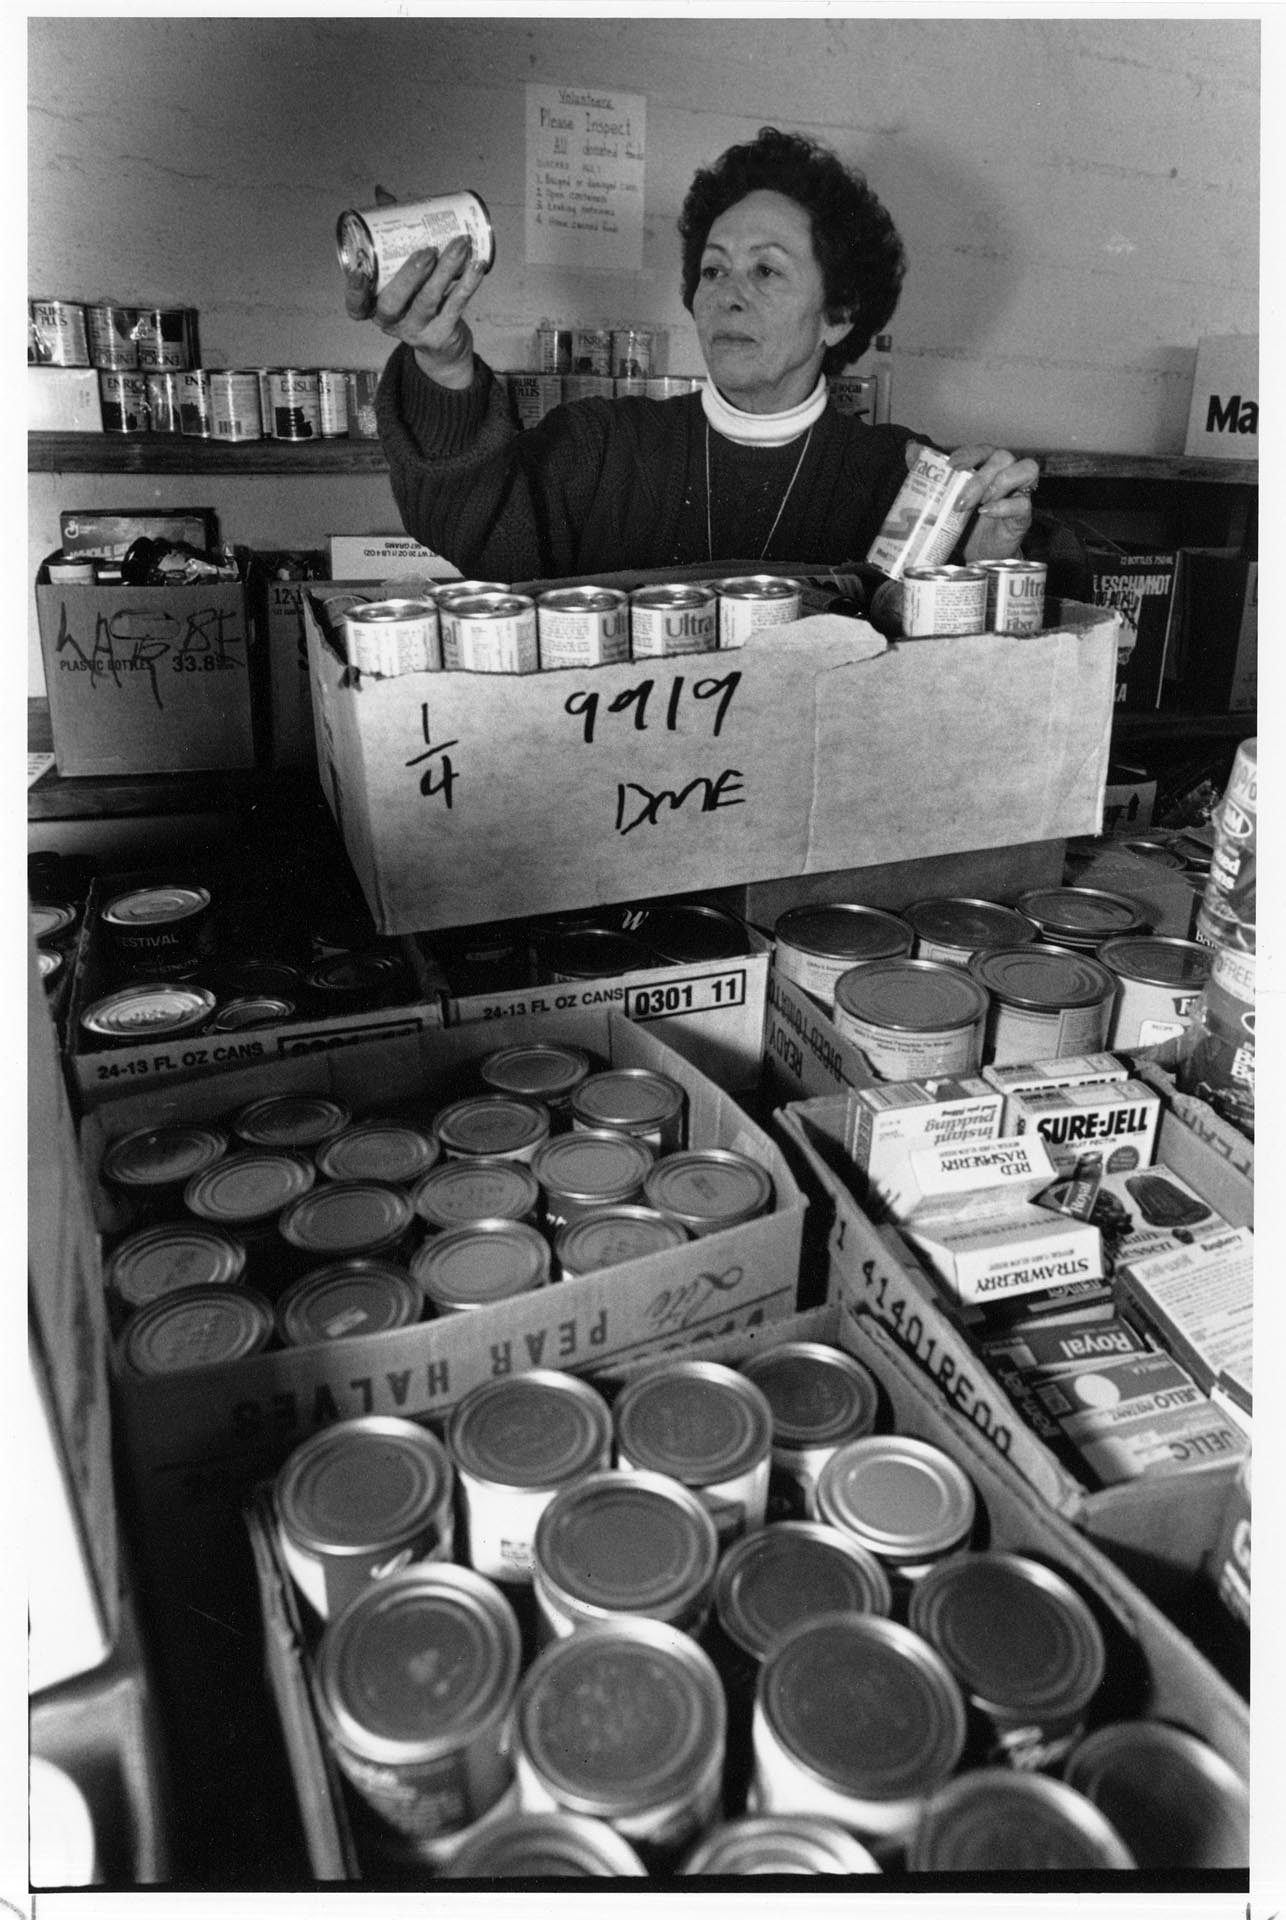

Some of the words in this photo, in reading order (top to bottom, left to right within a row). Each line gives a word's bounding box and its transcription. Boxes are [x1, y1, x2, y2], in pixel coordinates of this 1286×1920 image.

[540, 108, 575, 131] Please
[586, 112, 631, 138] Inspect
[1205, 394, 1259, 434] Ma
[384, 542, 409, 550] GRAMS
[1127, 555, 1152, 566] BOTTLES
[665, 612, 714, 638] Ultra
[564, 671, 743, 744] 9919
[484, 1001, 527, 1021] 24-13
[531, 998, 551, 1015] FL
[555, 994, 577, 1011] OZ
[581, 987, 625, 1006] CANS
[634, 984, 694, 1016] 0301
[711, 976, 738, 1003] 11
[97, 1058, 150, 1081] 24-13
[153, 1053, 177, 1072] FL
[181, 1049, 210, 1068] OZ
[212, 1040, 265, 1064] CANS
[768, 1021, 804, 1080] READY
[923, 1110, 996, 1133] pudding
[933, 1126, 993, 1147] instant
[1064, 1140, 1087, 1150] FRUIT
[1088, 1137, 1117, 1147] PECTIN
[940, 1149, 1028, 1173] RASPBERRY
[1000, 1160, 1033, 1177] RED
[1070, 1181, 1093, 1214] Royal
[974, 1257, 1090, 1295] STRAWBERRY
[490, 1308, 609, 1376] PEAR
[1060, 1331, 1134, 1359] Royal
